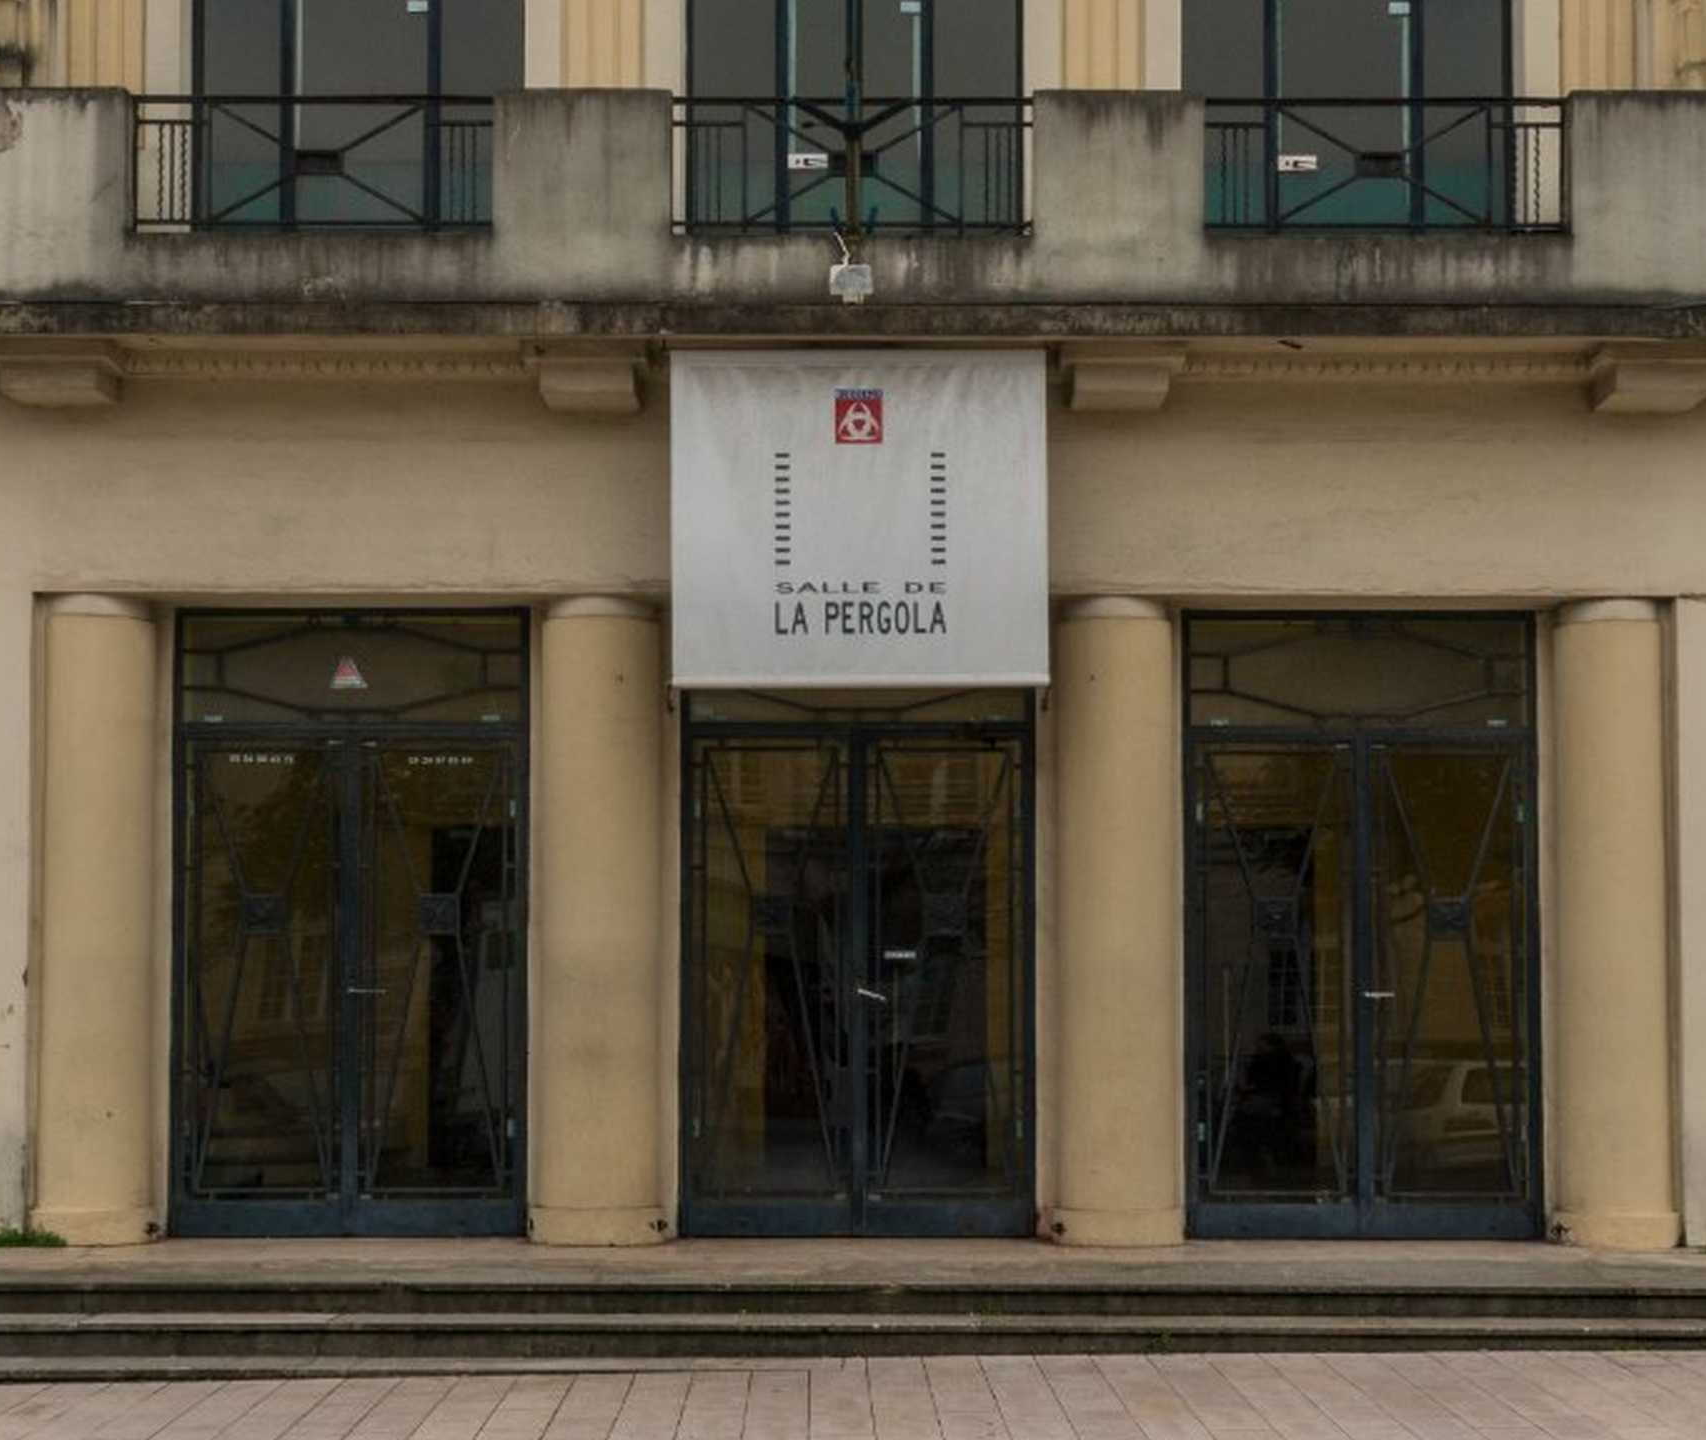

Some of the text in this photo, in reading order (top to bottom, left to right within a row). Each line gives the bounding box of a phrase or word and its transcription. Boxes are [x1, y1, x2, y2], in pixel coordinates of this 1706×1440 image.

[776, 581, 947, 594] SALLE DE
[774, 600, 948, 635] LA PERGOLA
